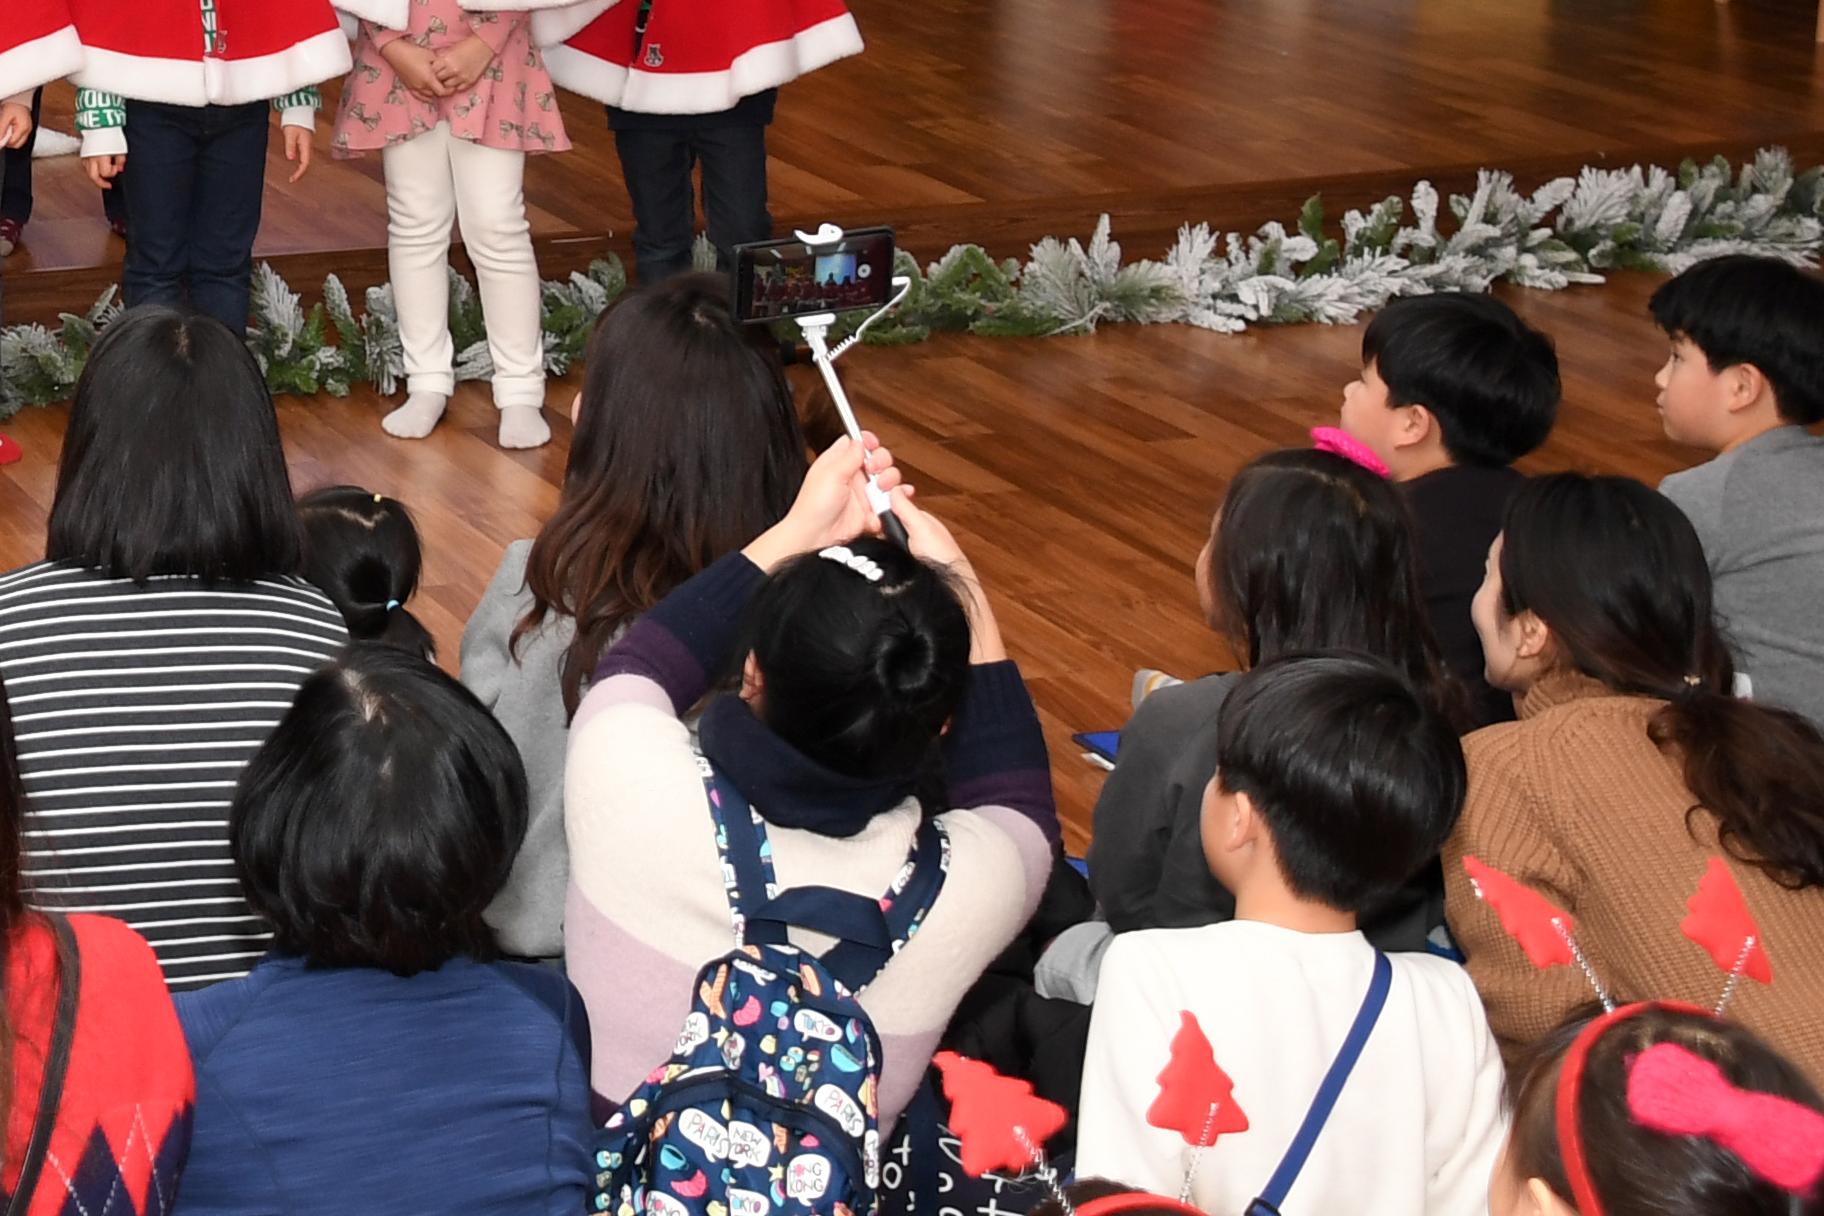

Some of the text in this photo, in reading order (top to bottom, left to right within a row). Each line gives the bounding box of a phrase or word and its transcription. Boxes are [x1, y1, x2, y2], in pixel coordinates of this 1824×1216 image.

[824, 1088, 863, 1132] PARIS
[686, 1112, 731, 1155] PARIS
[733, 1127, 762, 1146] NEW
[789, 1178, 824, 1194] KONG
